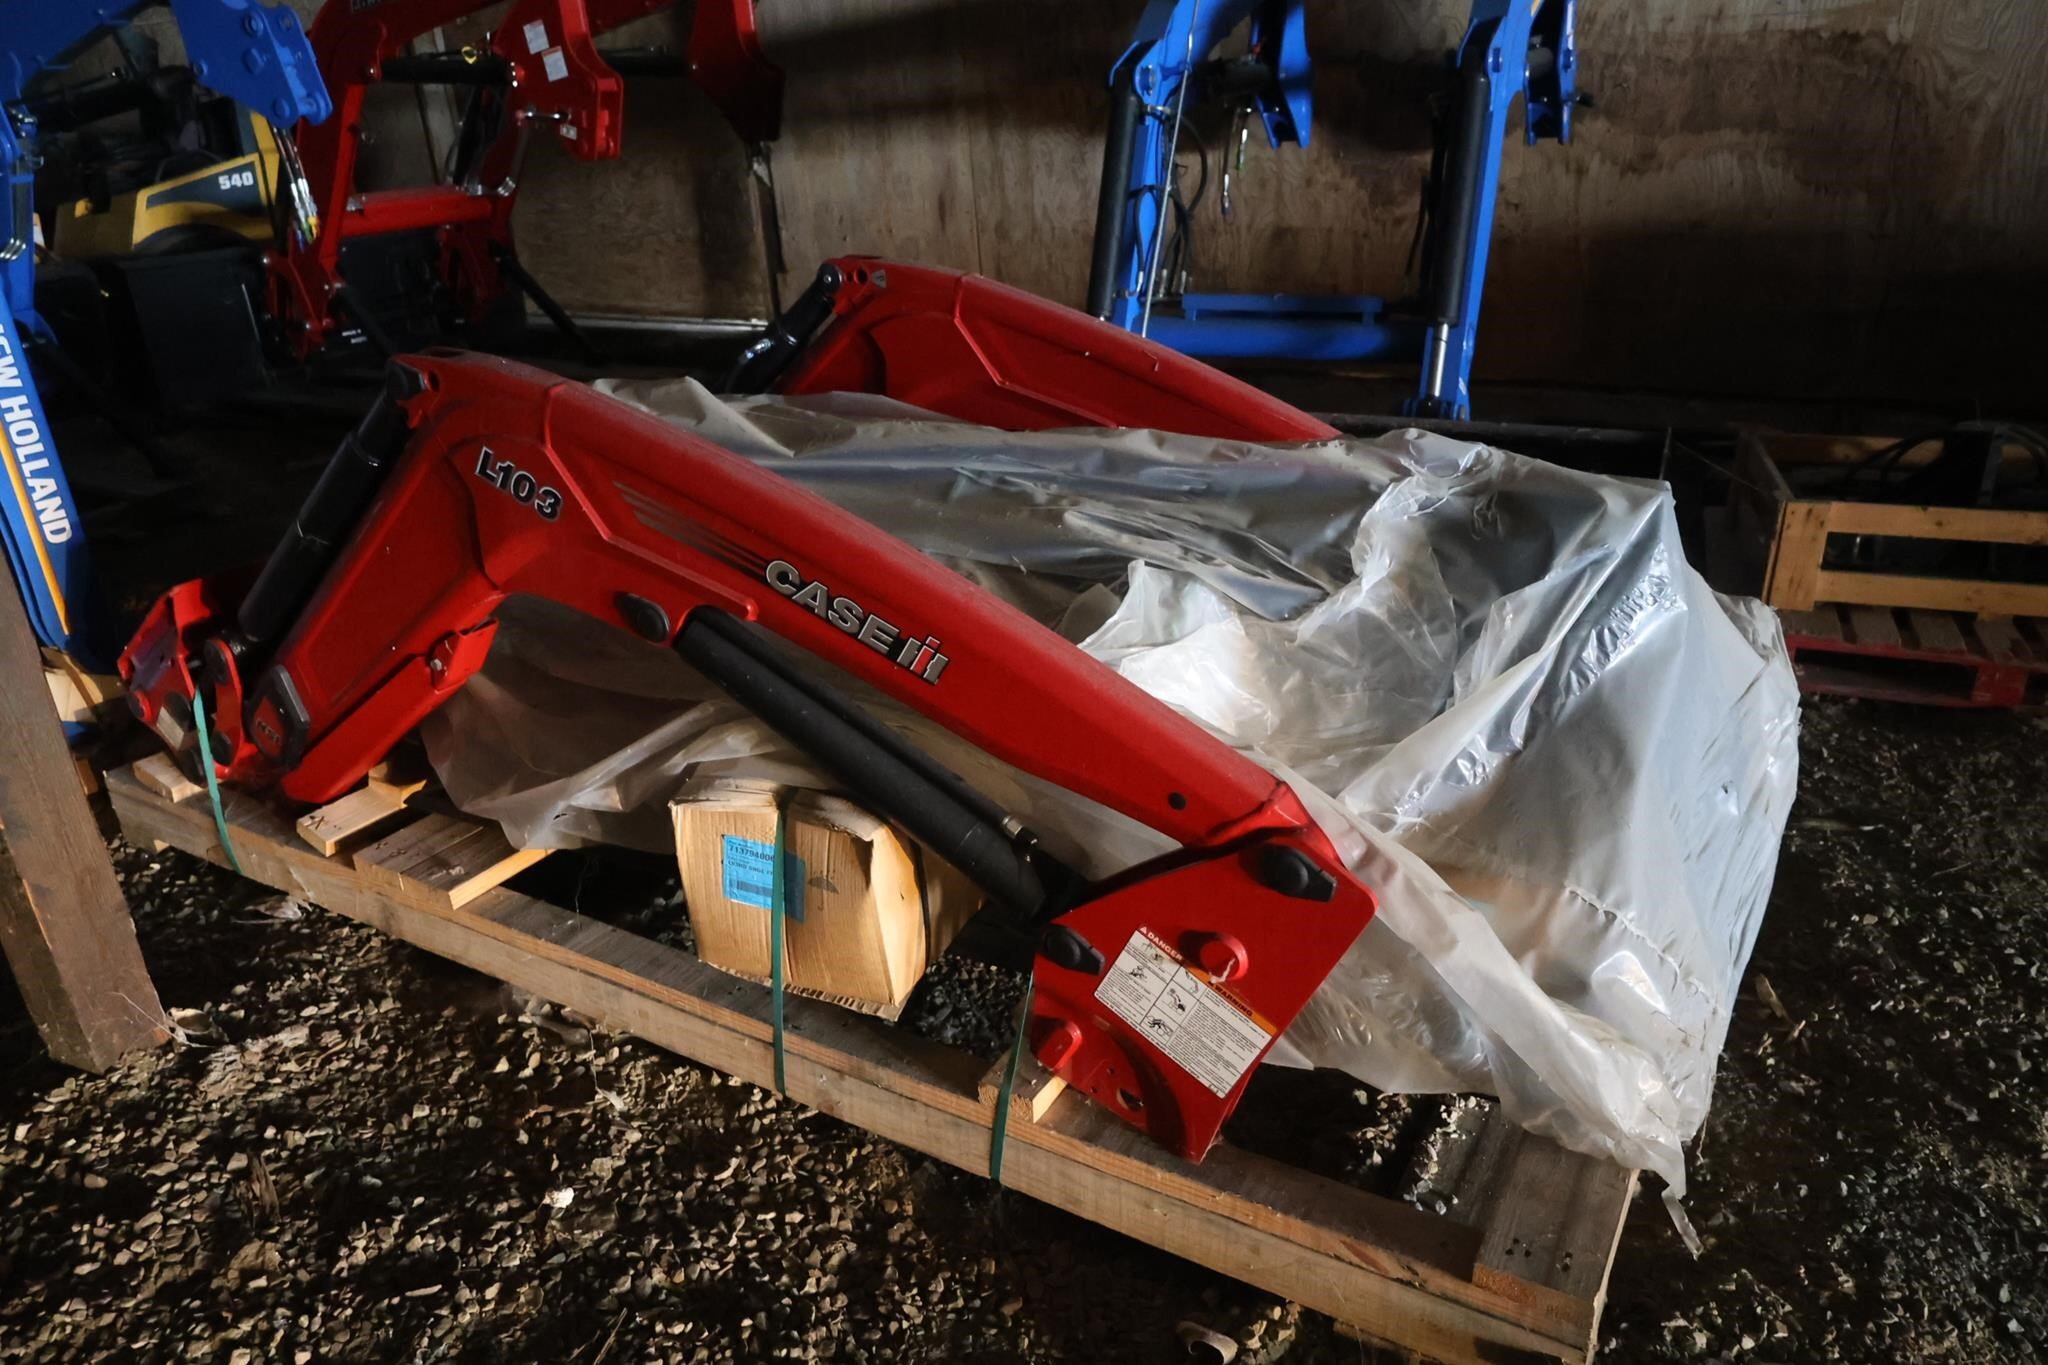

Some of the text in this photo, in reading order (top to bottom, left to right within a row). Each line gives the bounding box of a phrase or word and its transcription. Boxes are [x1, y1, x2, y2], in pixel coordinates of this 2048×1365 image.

[218, 171, 254, 190] 540
[0, 394, 73, 544] HOLLAND
[475, 446, 563, 521] L103
[766, 560, 900, 655] CASE
[1147, 931, 1184, 961] DANGER
[1215, 985, 1254, 1017] WARNING
